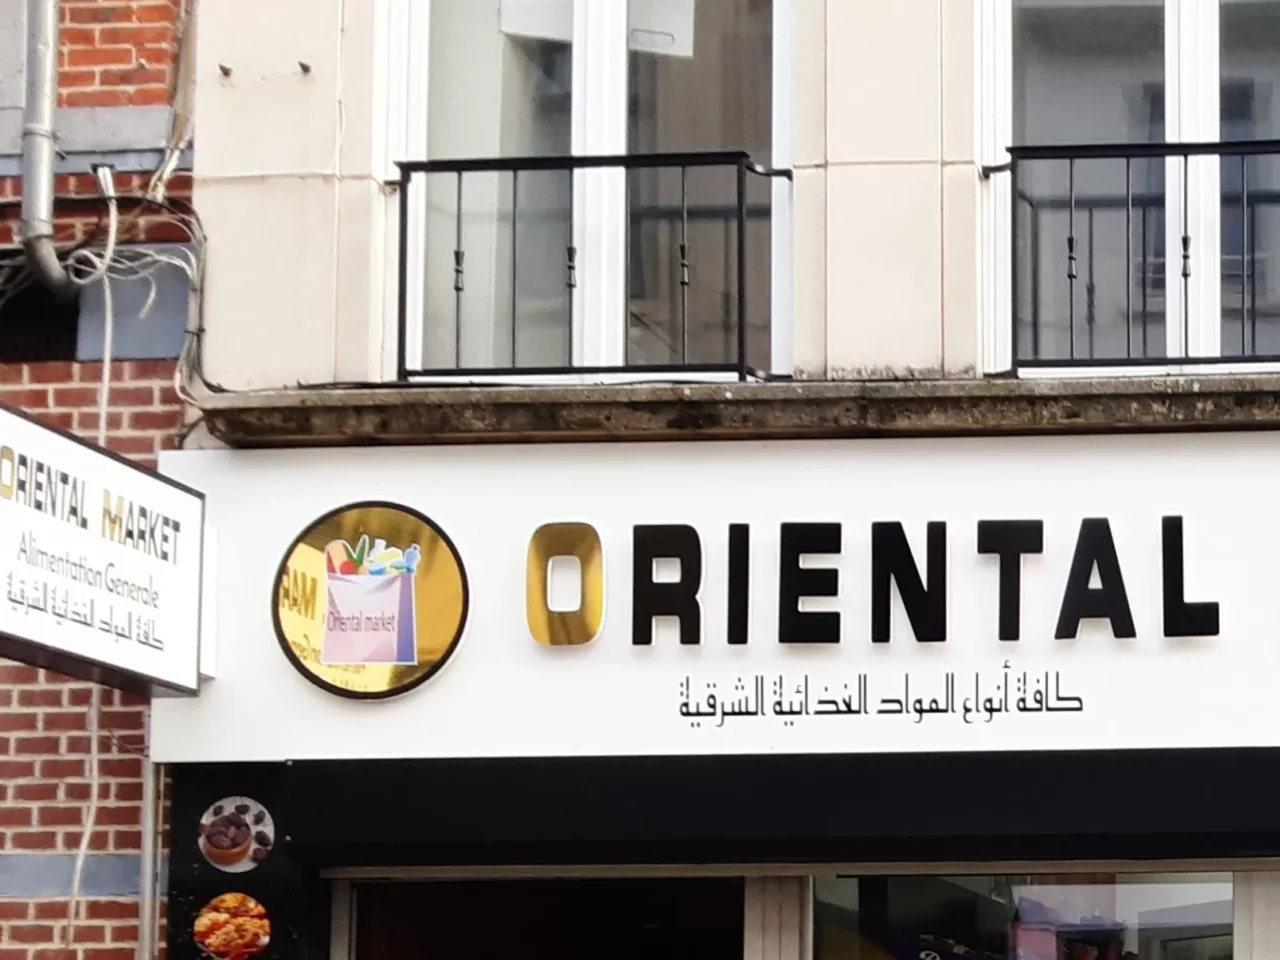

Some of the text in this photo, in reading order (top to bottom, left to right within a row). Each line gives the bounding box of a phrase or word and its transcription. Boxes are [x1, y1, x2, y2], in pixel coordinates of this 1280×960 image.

[0, 445, 181, 565] ORIENTAL MARKET
[17, 529, 160, 609] Alimentation Generale
[526, 515, 1220, 648] ORIENTAL
[98, 603, 134, 644] المواد
[327, 608, 396, 633] Oriental market
[679, 660, 1084, 728] كافة أنواع المواد الغذائية الشرقية
